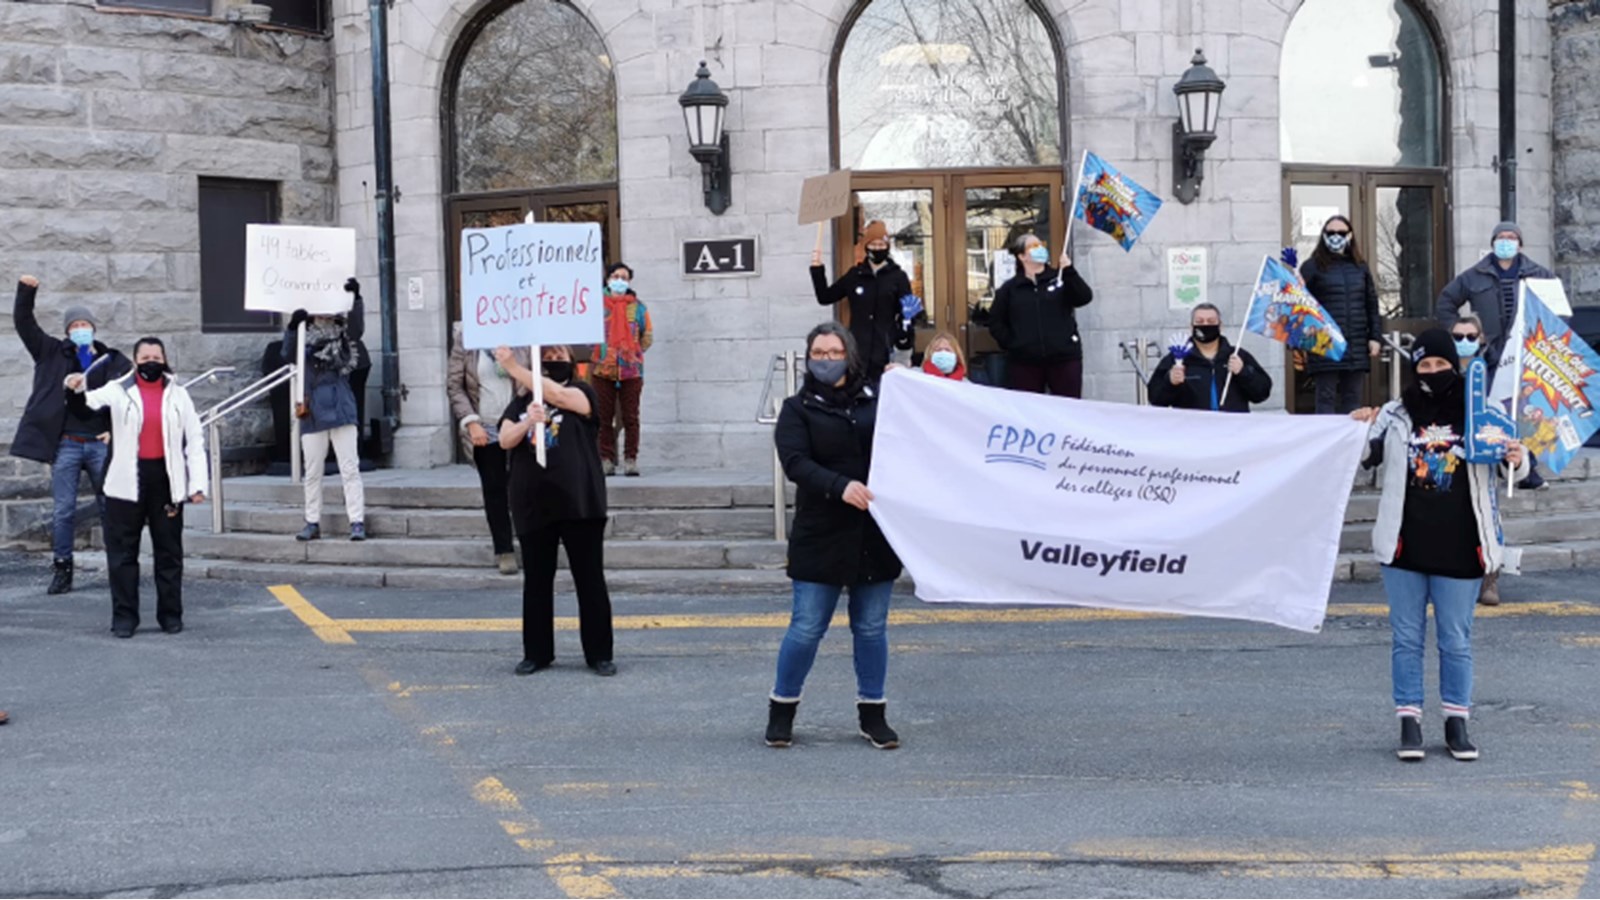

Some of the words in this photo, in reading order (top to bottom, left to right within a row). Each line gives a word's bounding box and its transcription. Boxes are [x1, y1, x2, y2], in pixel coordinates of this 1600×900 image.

[261, 235, 280, 259] 49
[467, 229, 599, 276] Professionnels
[693, 243, 745, 271] A-1
[518, 273, 537, 290] et
[476, 278, 590, 326] essentiels
[1522, 348, 1588, 409] INTENANT
[986, 424, 1056, 456] FPPC
[1061, 435, 1135, 458] Fédération
[1058, 456, 1076, 470] du
[1079, 463, 1148, 477] personnel
[1149, 467, 1240, 485] professionnel
[1056, 477, 1077, 493] des
[1080, 480, 1132, 501] collèges
[1137, 485, 1177, 504] (CSQ)
[1020, 540, 1188, 576] Valleyfield
